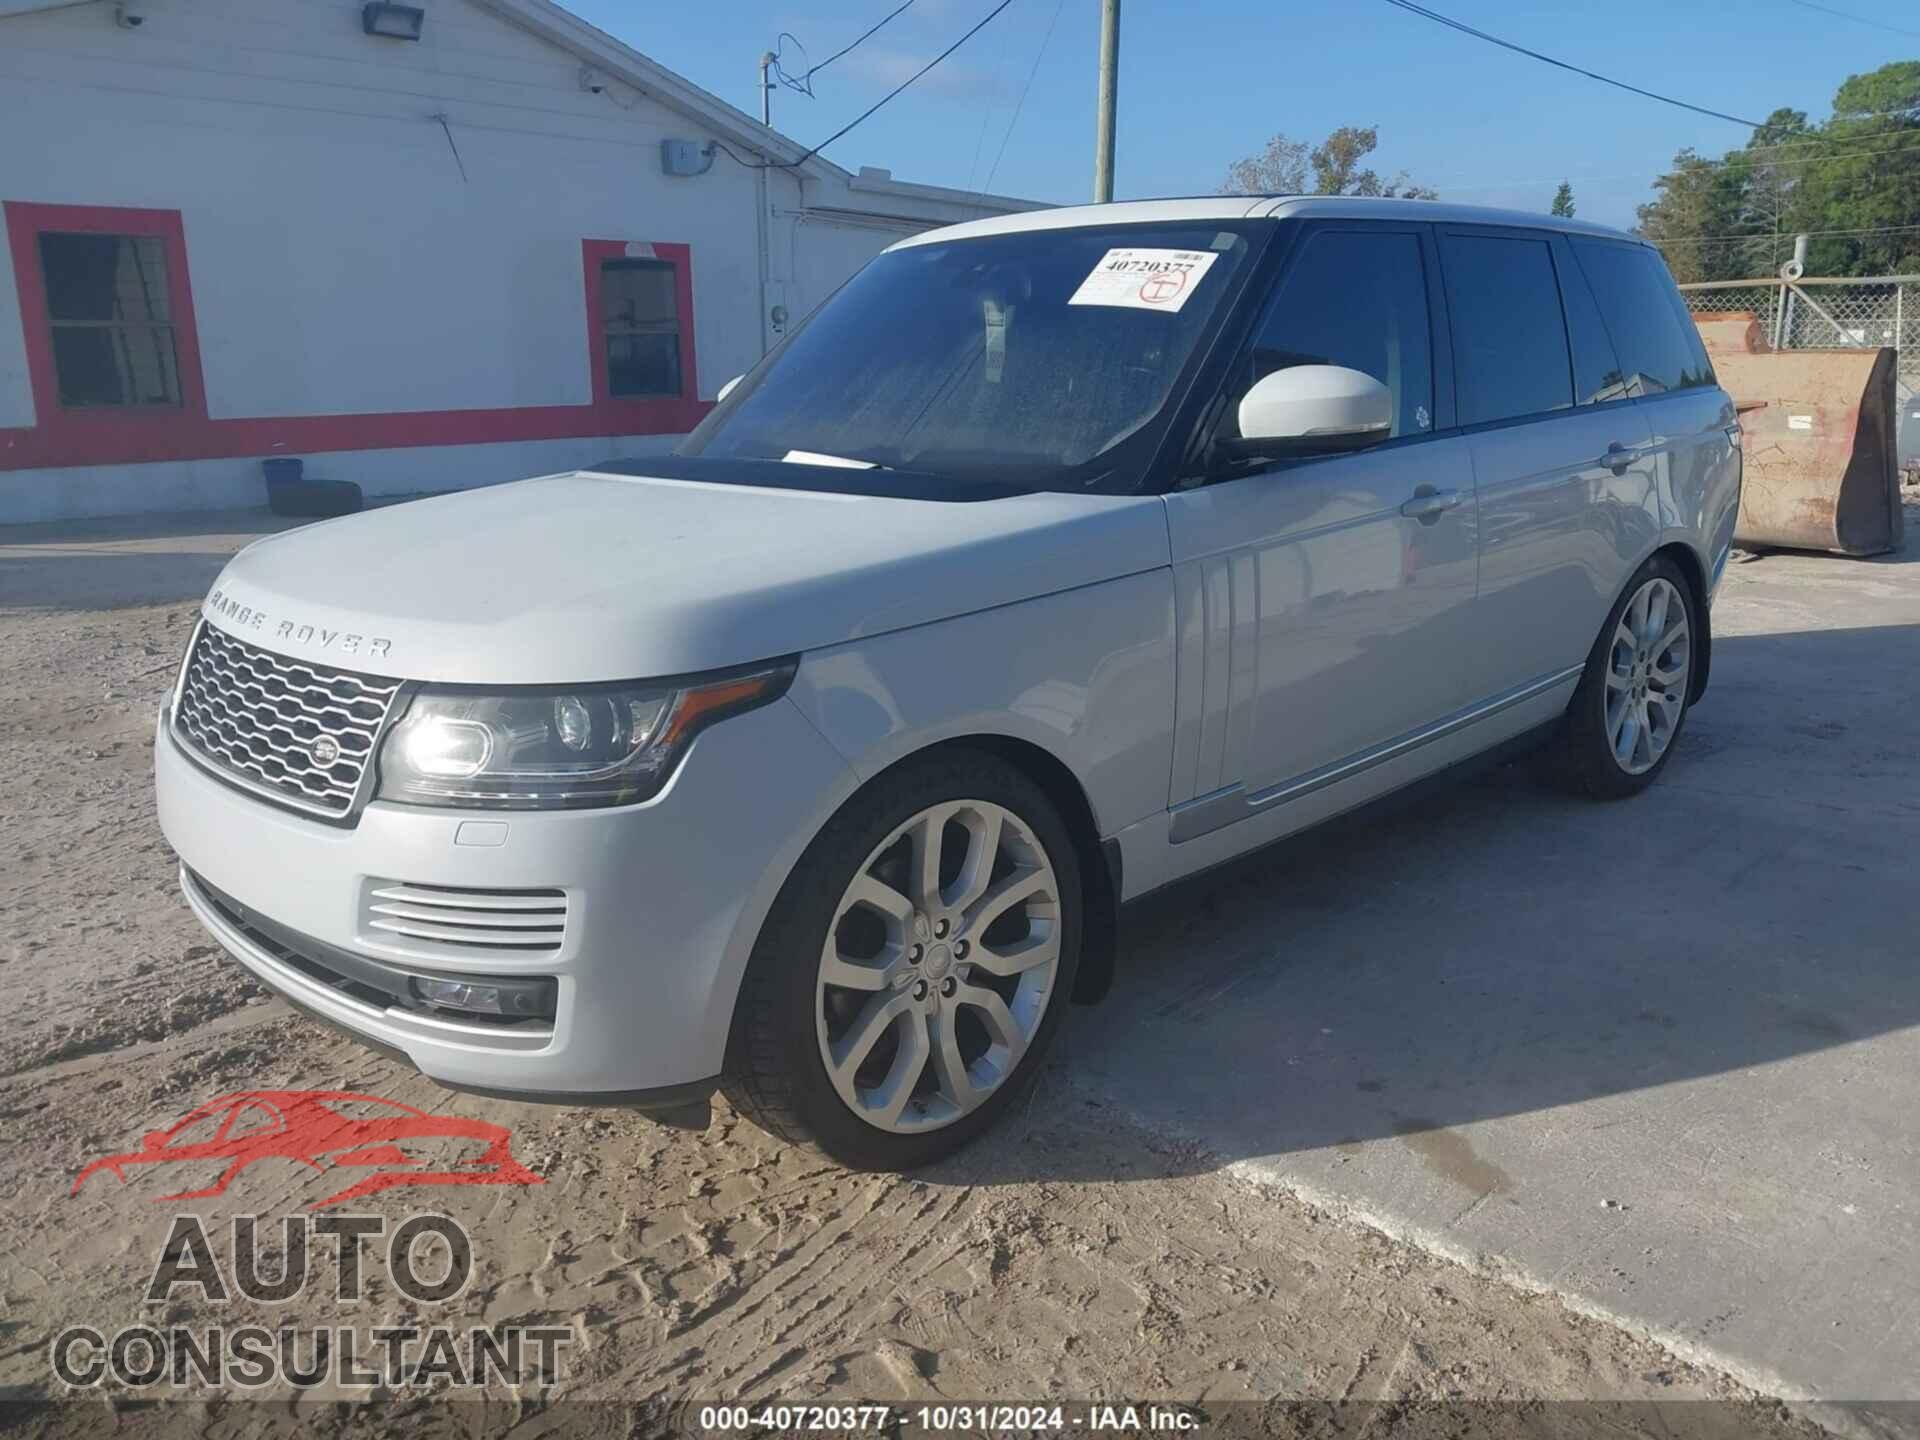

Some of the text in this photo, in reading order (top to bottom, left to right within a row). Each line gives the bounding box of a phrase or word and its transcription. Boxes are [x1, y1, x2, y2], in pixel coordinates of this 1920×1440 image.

[1106, 260, 1194, 273] 40720377
[210, 590, 392, 658] RANGE ROVER
